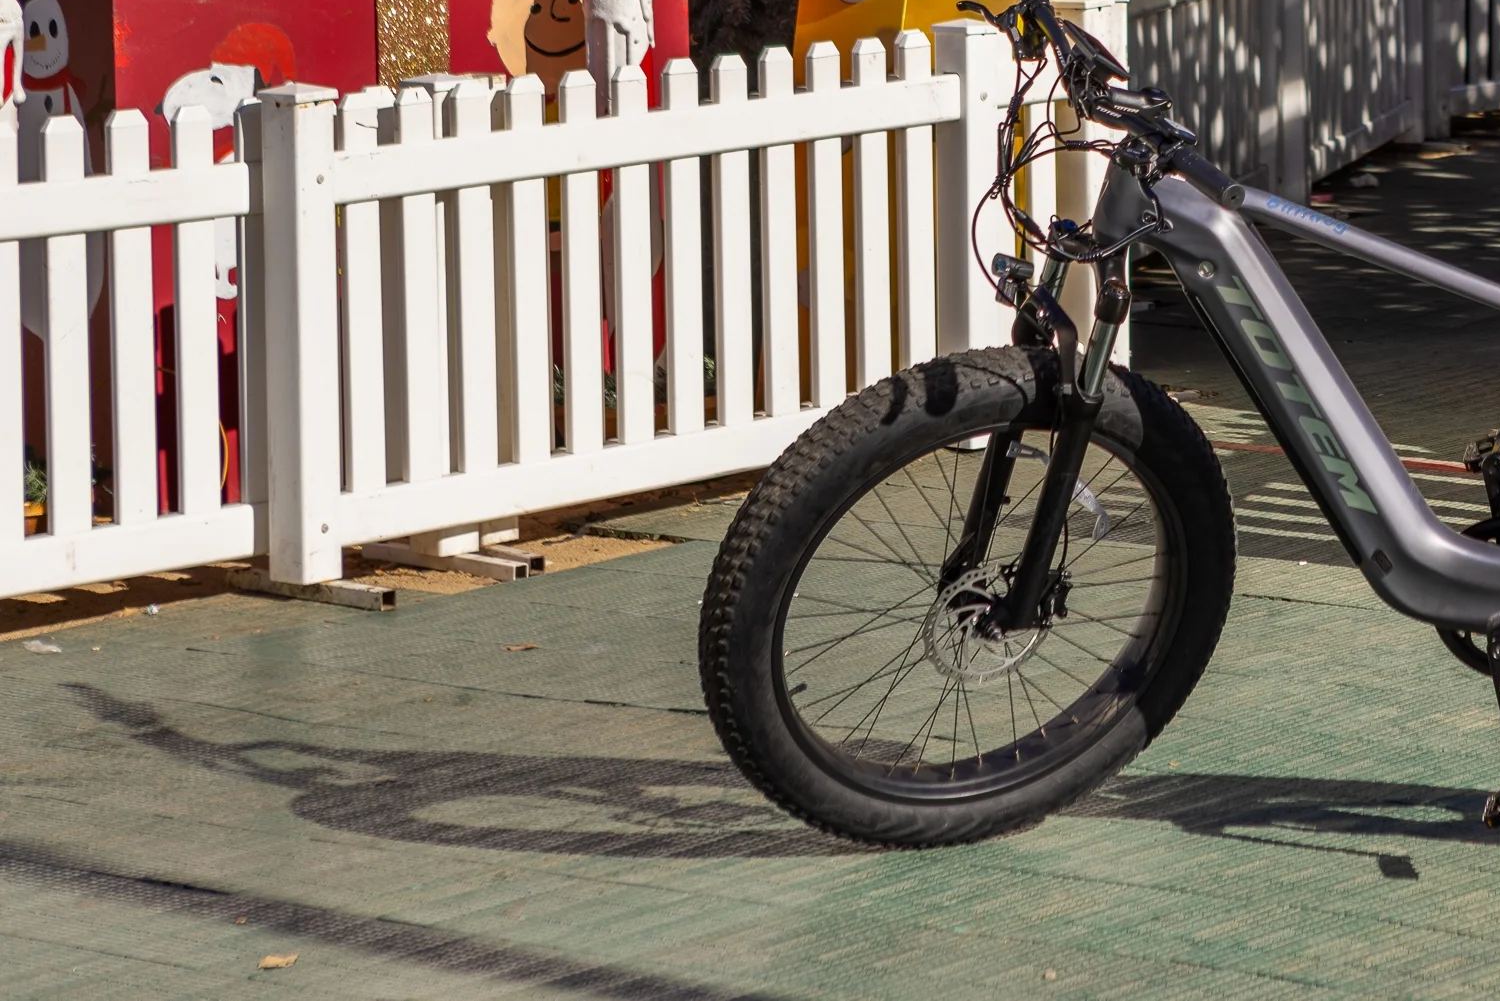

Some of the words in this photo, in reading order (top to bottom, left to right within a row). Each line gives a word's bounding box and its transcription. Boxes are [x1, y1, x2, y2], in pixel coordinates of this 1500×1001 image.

[1095, 105, 1122, 119] TOTEM
[1113, 104, 1140, 114] TOTEM
[1216, 275, 1378, 515] TOTEM
